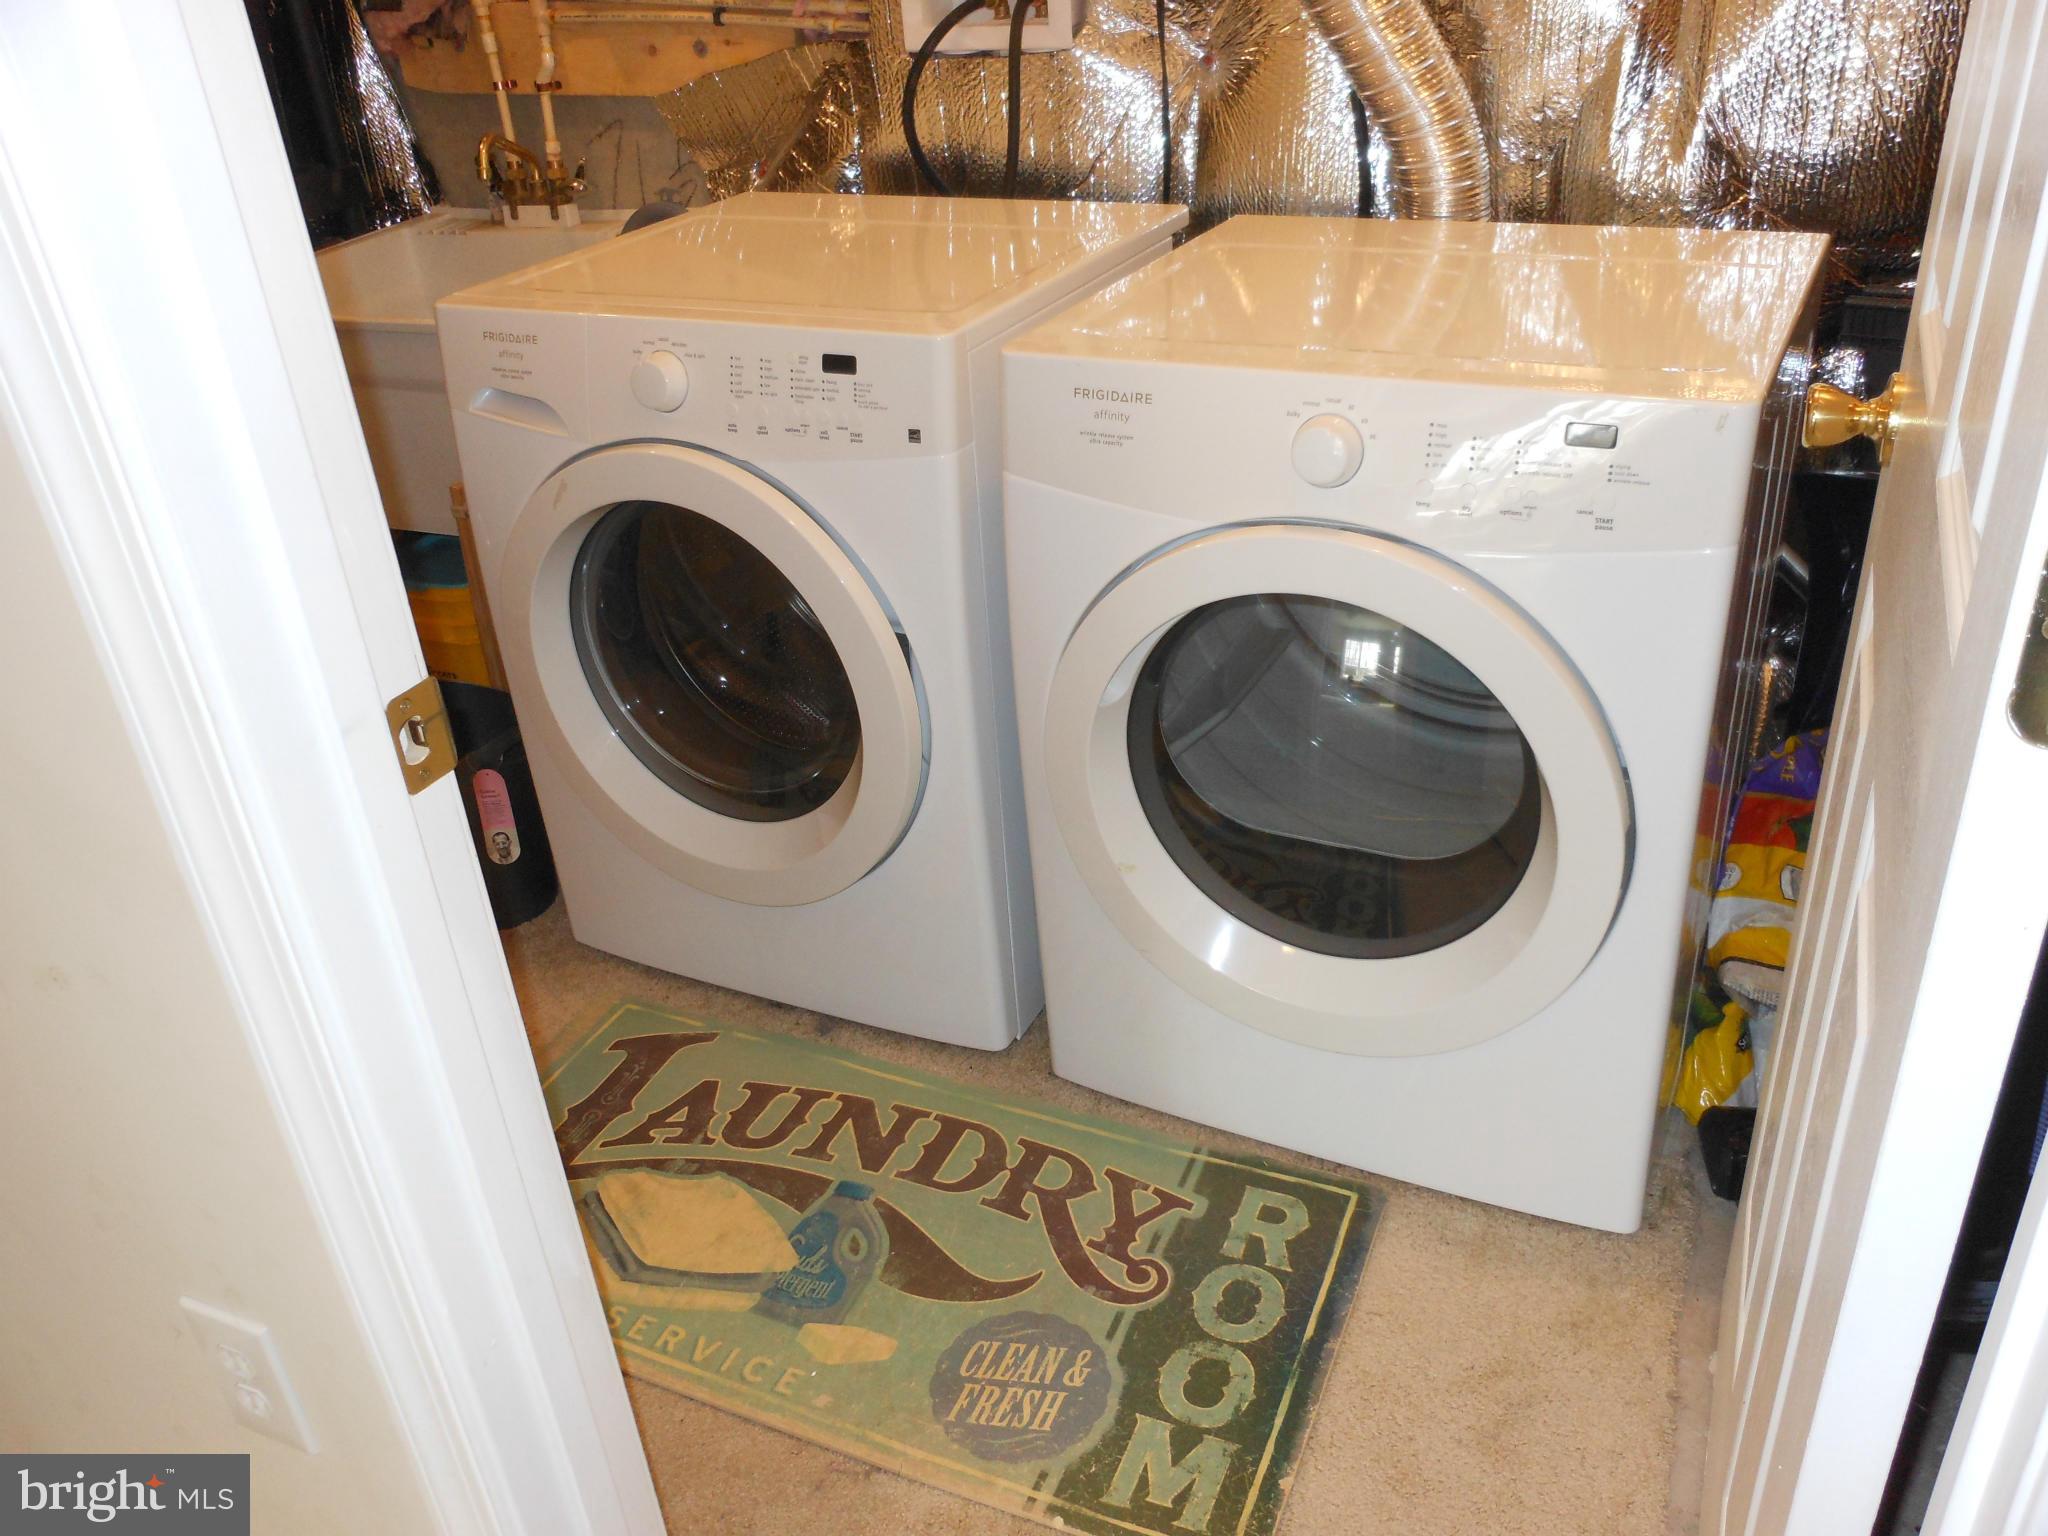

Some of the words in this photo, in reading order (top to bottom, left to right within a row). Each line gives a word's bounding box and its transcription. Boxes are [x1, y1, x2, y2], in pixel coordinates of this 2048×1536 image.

[482, 331, 538, 345] FRIGIDAIRE
[1074, 387, 1153, 405] FRIGIDAIRE
[1094, 409, 1130, 424] affinity
[1595, 517, 1614, 525] START
[557, 1031, 1195, 1304] LAUNDRY
[607, 1305, 806, 1396] SERVICE
[959, 1340, 1068, 1384] CLEAN
[1062, 1349, 1093, 1387] &
[1098, 1184, 1310, 1532] ROOM
[946, 1383, 1069, 1431] FRESH
